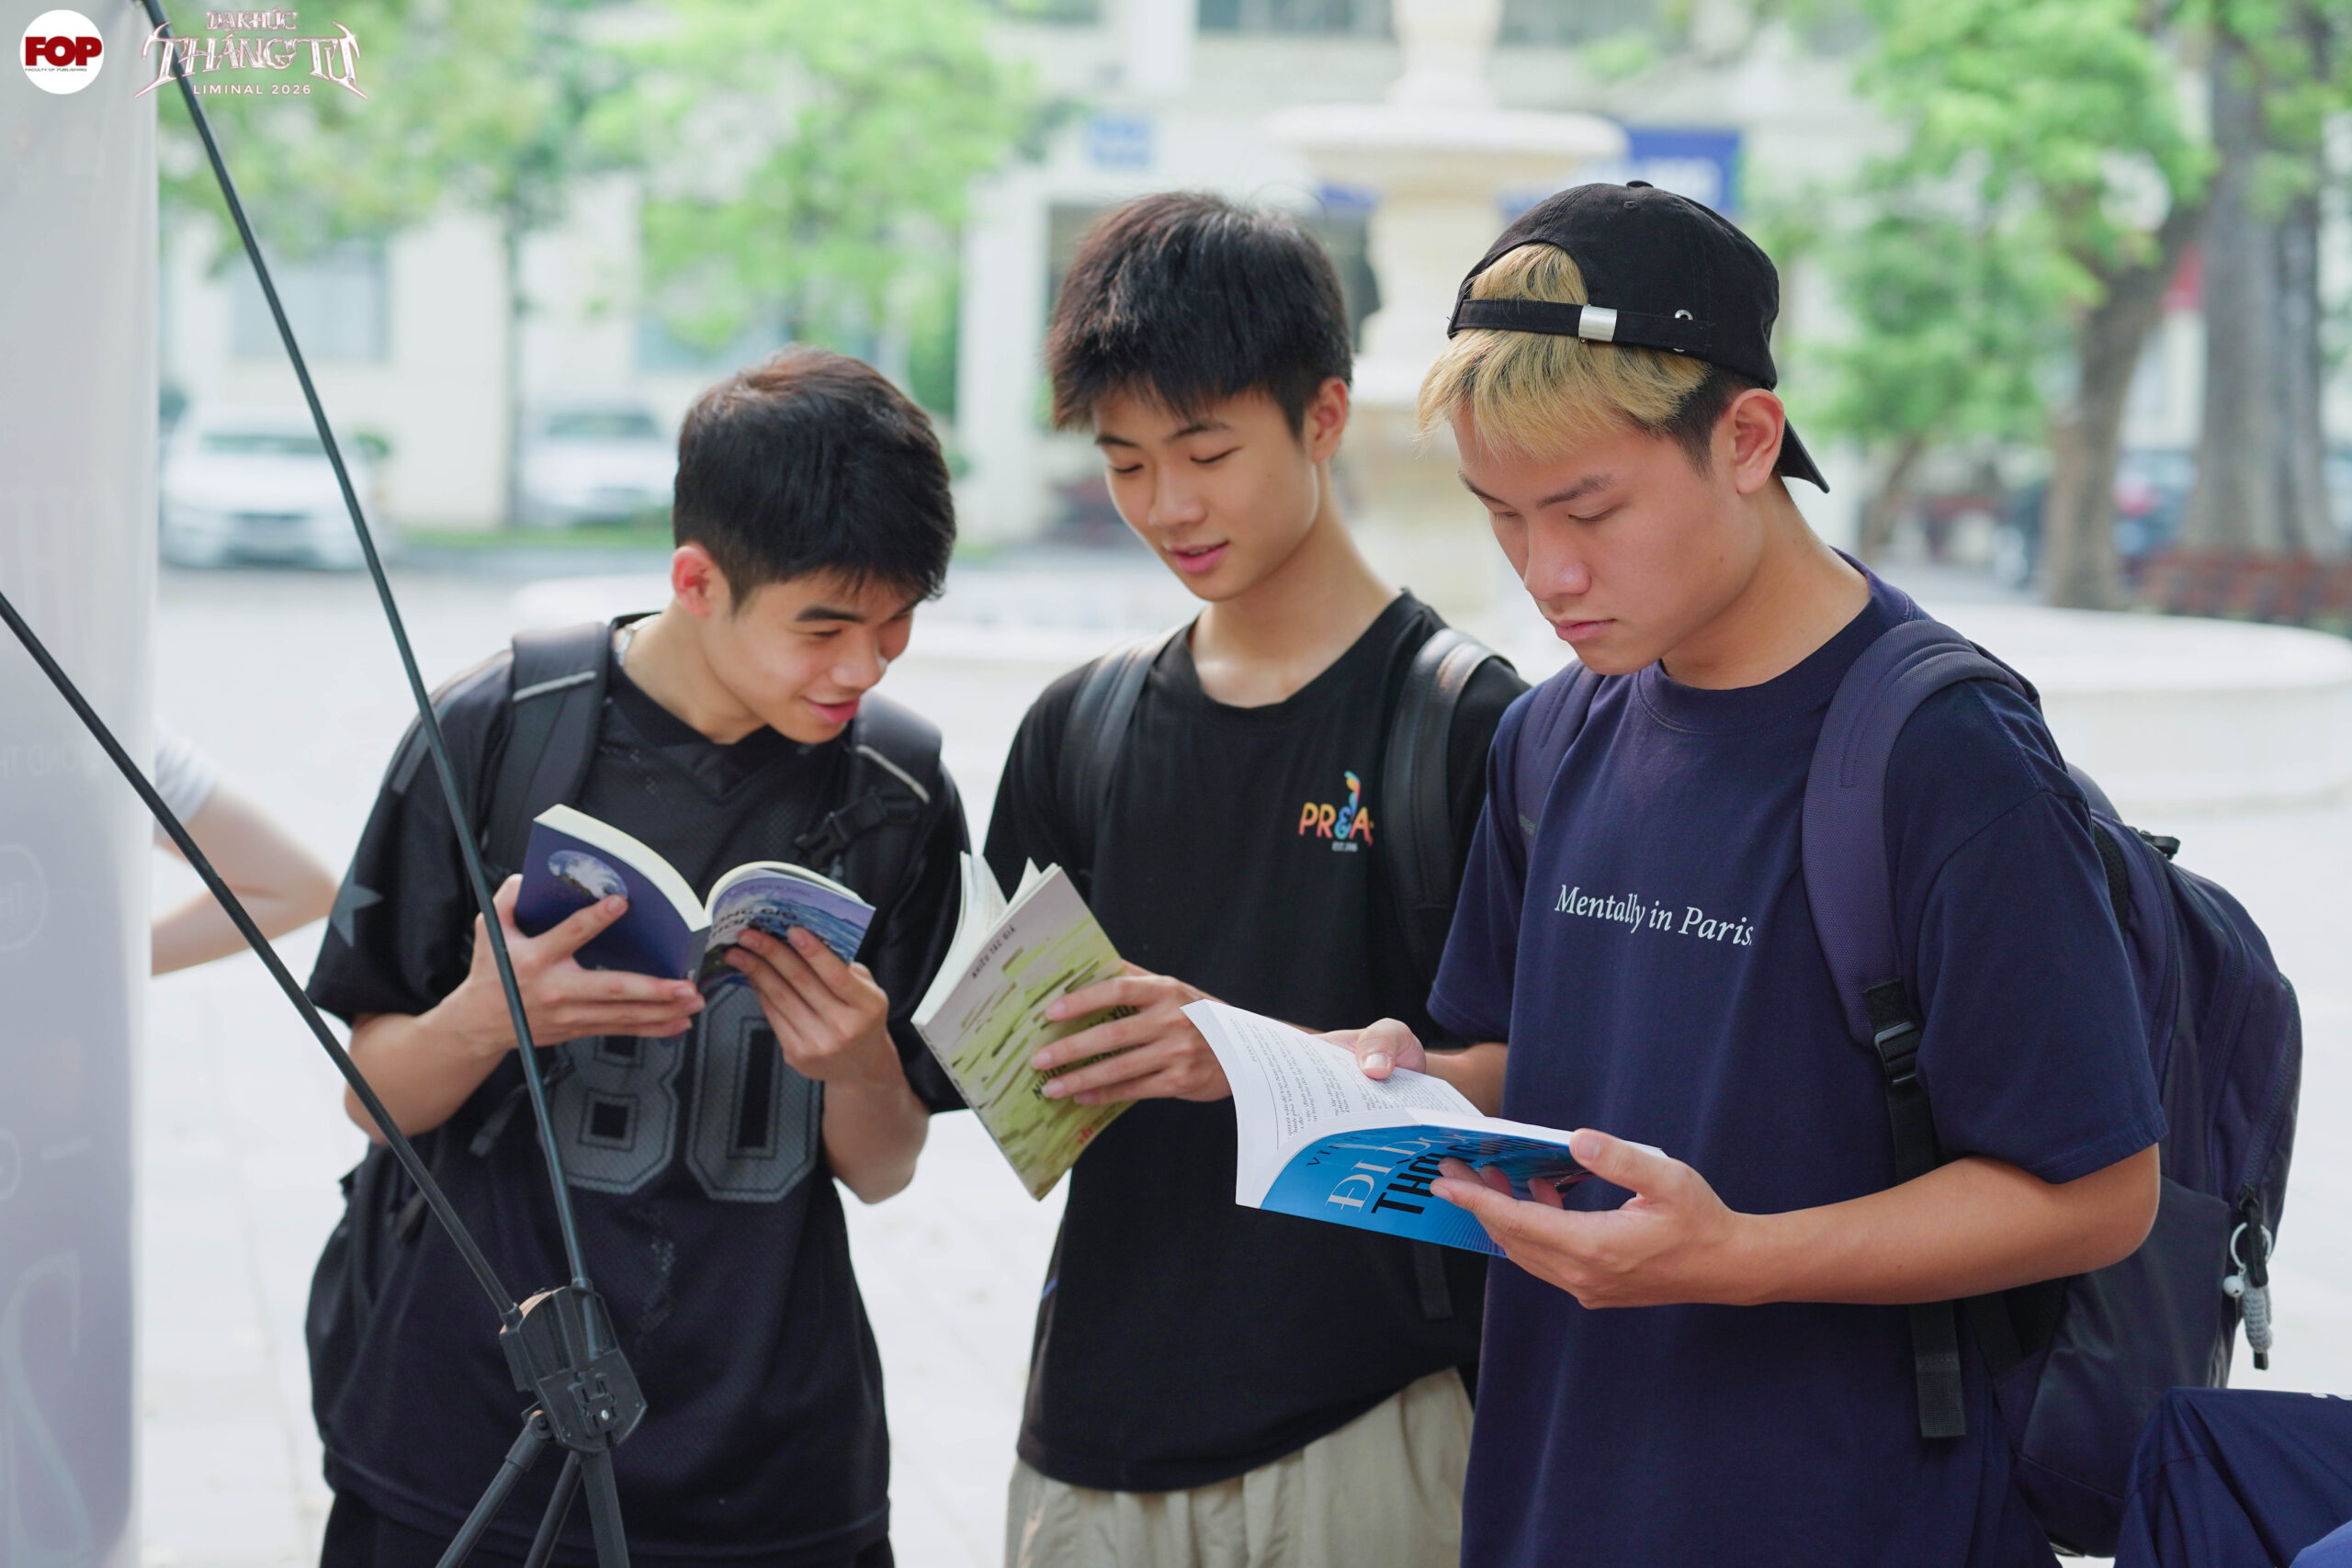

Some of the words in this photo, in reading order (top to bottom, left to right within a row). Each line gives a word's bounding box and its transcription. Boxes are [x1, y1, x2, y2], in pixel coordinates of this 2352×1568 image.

[1554, 884, 1646, 934] Mentally
[1648, 900, 1673, 931] in
[536, 981, 824, 1203] 80
[1325, 1158, 1396, 1213] ĐI
